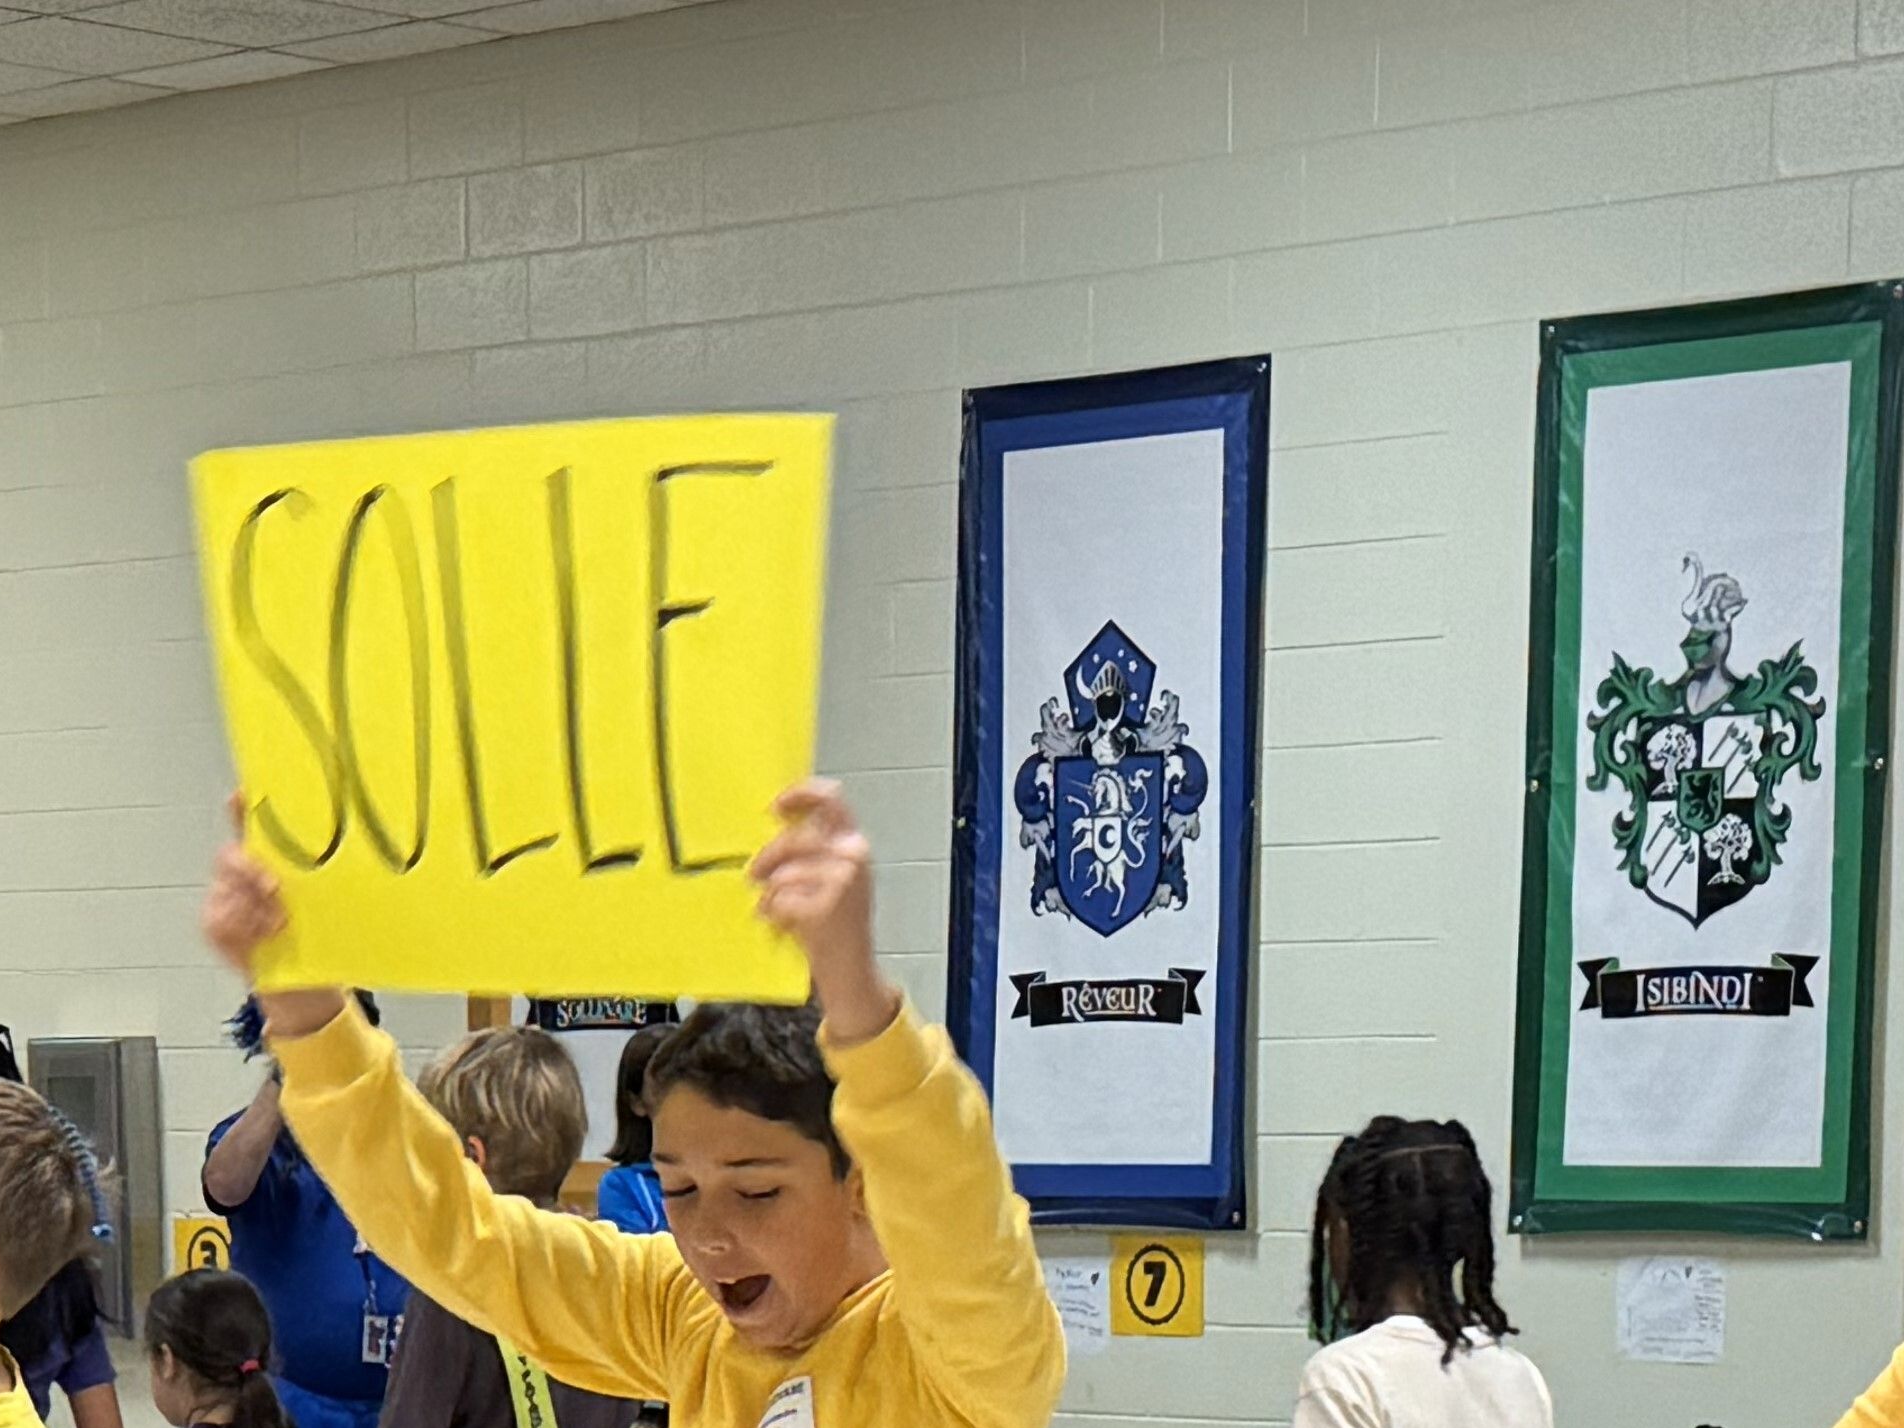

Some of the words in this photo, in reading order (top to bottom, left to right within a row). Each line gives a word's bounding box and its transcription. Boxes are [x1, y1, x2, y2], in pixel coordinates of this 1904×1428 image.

[228, 459, 779, 878] SOLLE
[1635, 971, 1753, 1012] ISIBINDI
[1143, 1261, 1166, 1307] 7
